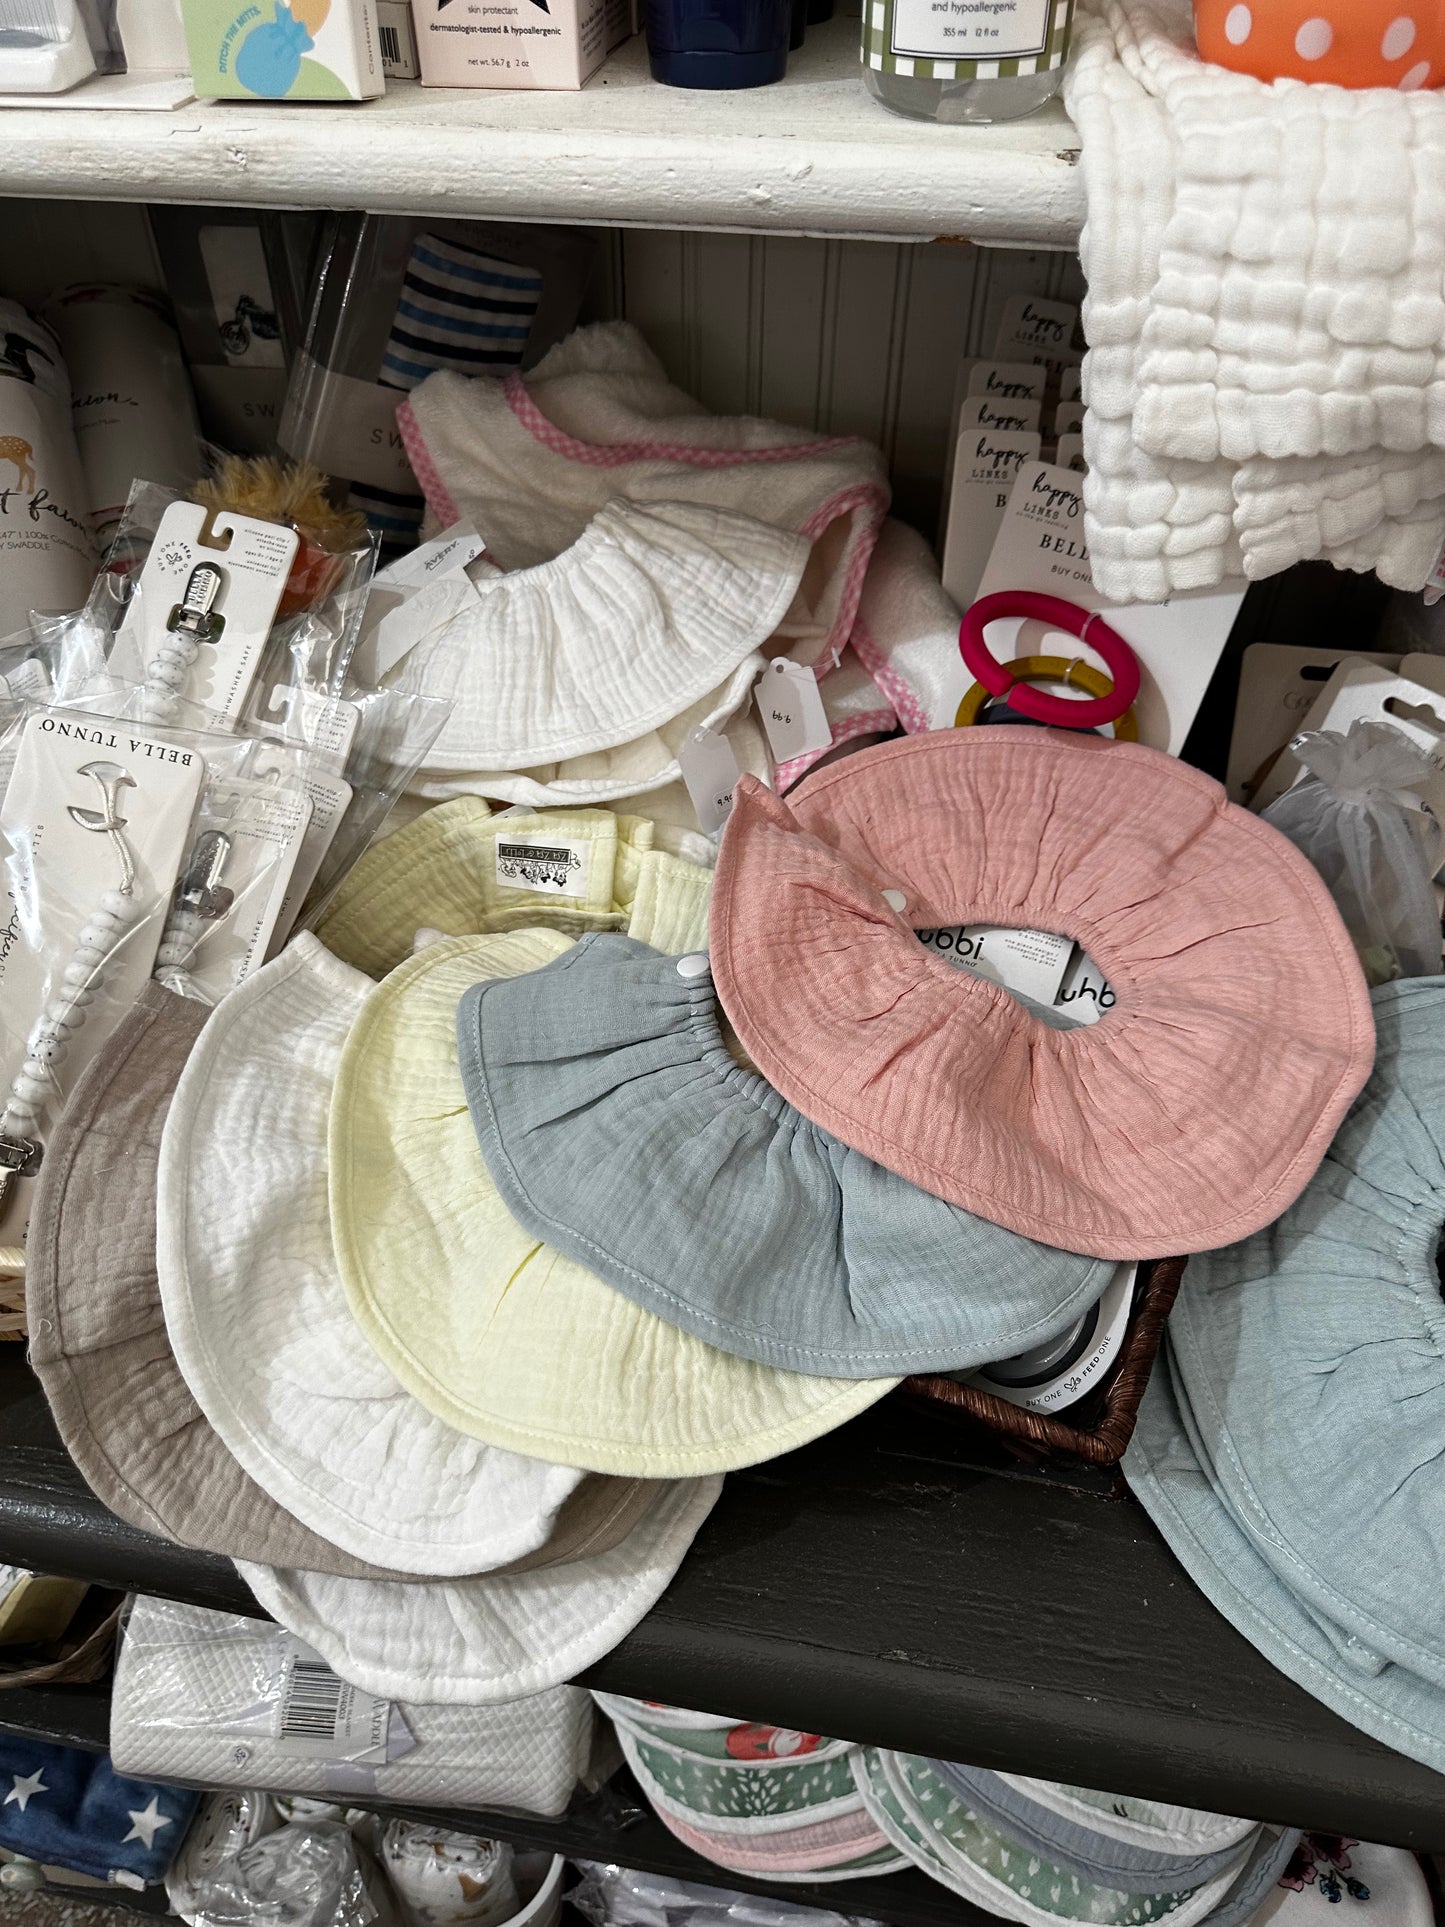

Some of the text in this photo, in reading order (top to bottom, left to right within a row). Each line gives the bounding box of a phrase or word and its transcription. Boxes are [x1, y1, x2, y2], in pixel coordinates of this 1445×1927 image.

[468, 6, 518, 16] skin protectant
[932, 2, 1016, 15] and hypoallergenic
[430, 23, 561, 37] dermatologist-tested & hypoallergenic
[943, 28, 956, 37] 355
[958, 28, 967, 37] ml
[219, 41, 231, 73] DITCH
[225, 24, 239, 41] THE
[1021, 304, 1067, 342] happy
[976, 437, 1029, 472] happy
[971, 469, 1008, 479] LINKS
[1032, 472, 1082, 518] happy
[1023, 502, 1060, 520] LINKS
[7, 541, 52, 551] SWADDLE
[1051, 565, 1092, 585] BUY ONE
[218, 645, 252, 725] DISHWASHER SAFE
[129, 739, 193, 767] BELLA
[536, 850, 550, 860] Zsa
[553, 852, 567, 861] Zsa
[251, 920, 263, 943] SAFE
[912, 926, 985, 960] ubbi
[1025, 1335, 1112, 1407] BUY ONE FEED ONE
